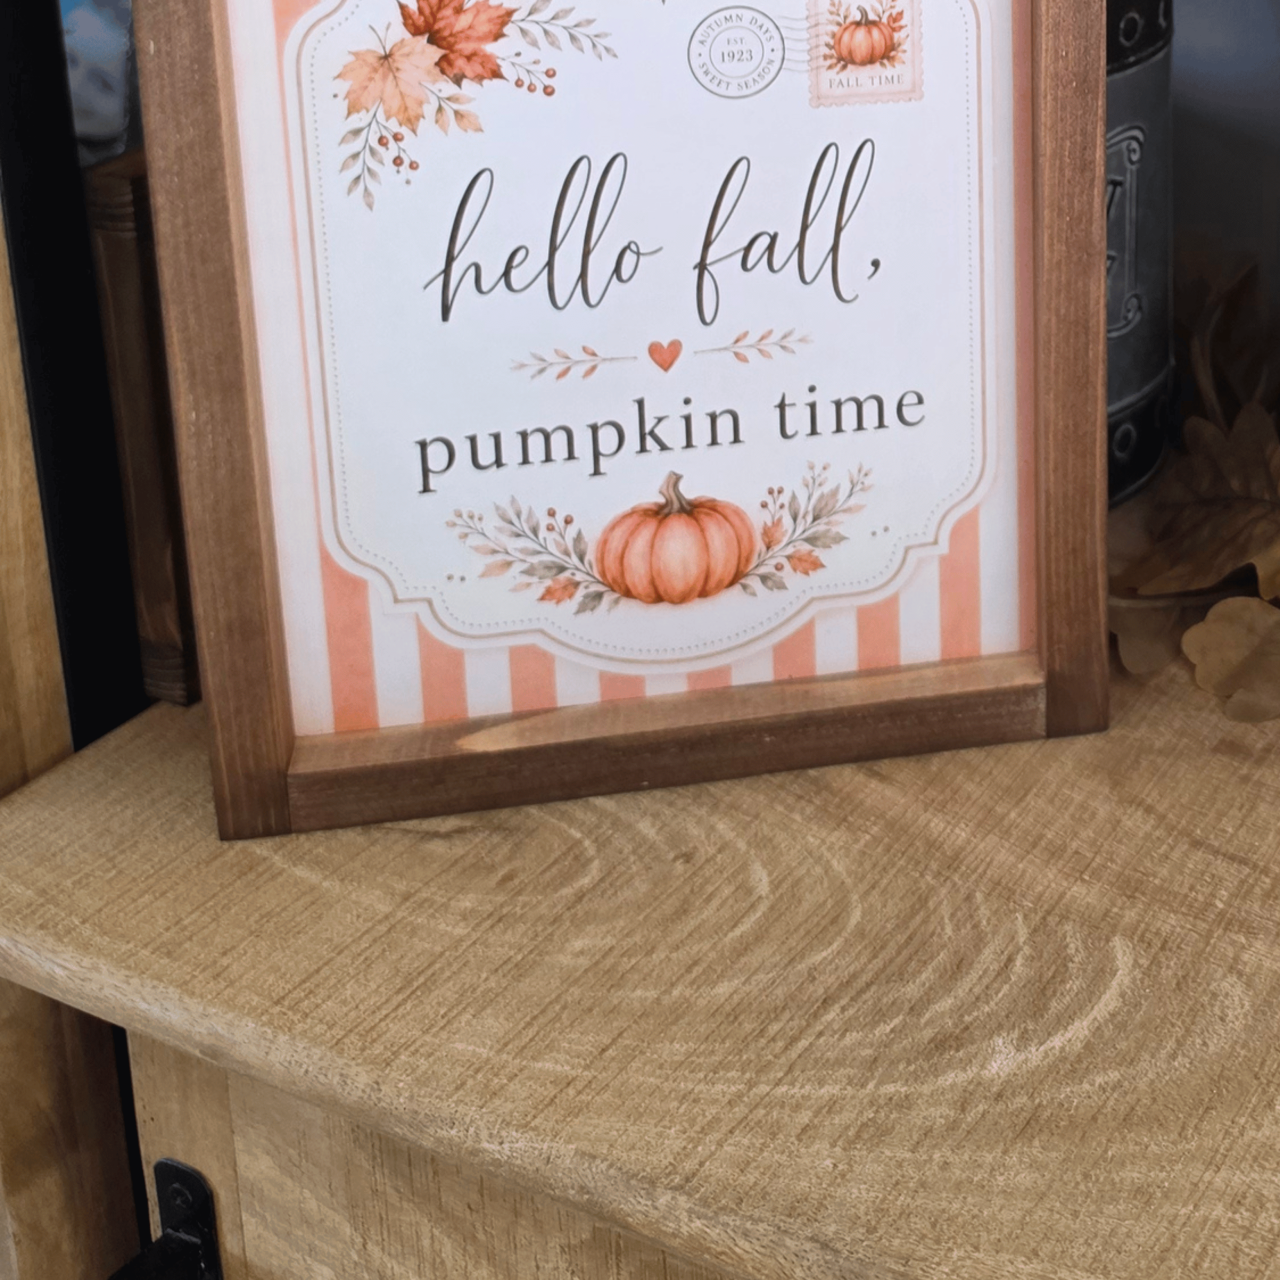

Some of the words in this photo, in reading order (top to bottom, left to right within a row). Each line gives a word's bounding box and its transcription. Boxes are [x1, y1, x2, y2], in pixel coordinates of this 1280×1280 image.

[698, 13, 744, 47] AUTUMN
[749, 16, 775, 43] DAYS
[721, 49, 754, 63] 1923
[699, 62, 731, 91] SWEET
[737, 58, 775, 91] SEASON
[829, 77, 862, 88] FALL
[869, 74, 904, 86] TIME
[423, 152, 663, 323] hello
[692, 138, 882, 326] fall,
[414, 396, 745, 494] pumpkin
[774, 384, 926, 441] time
